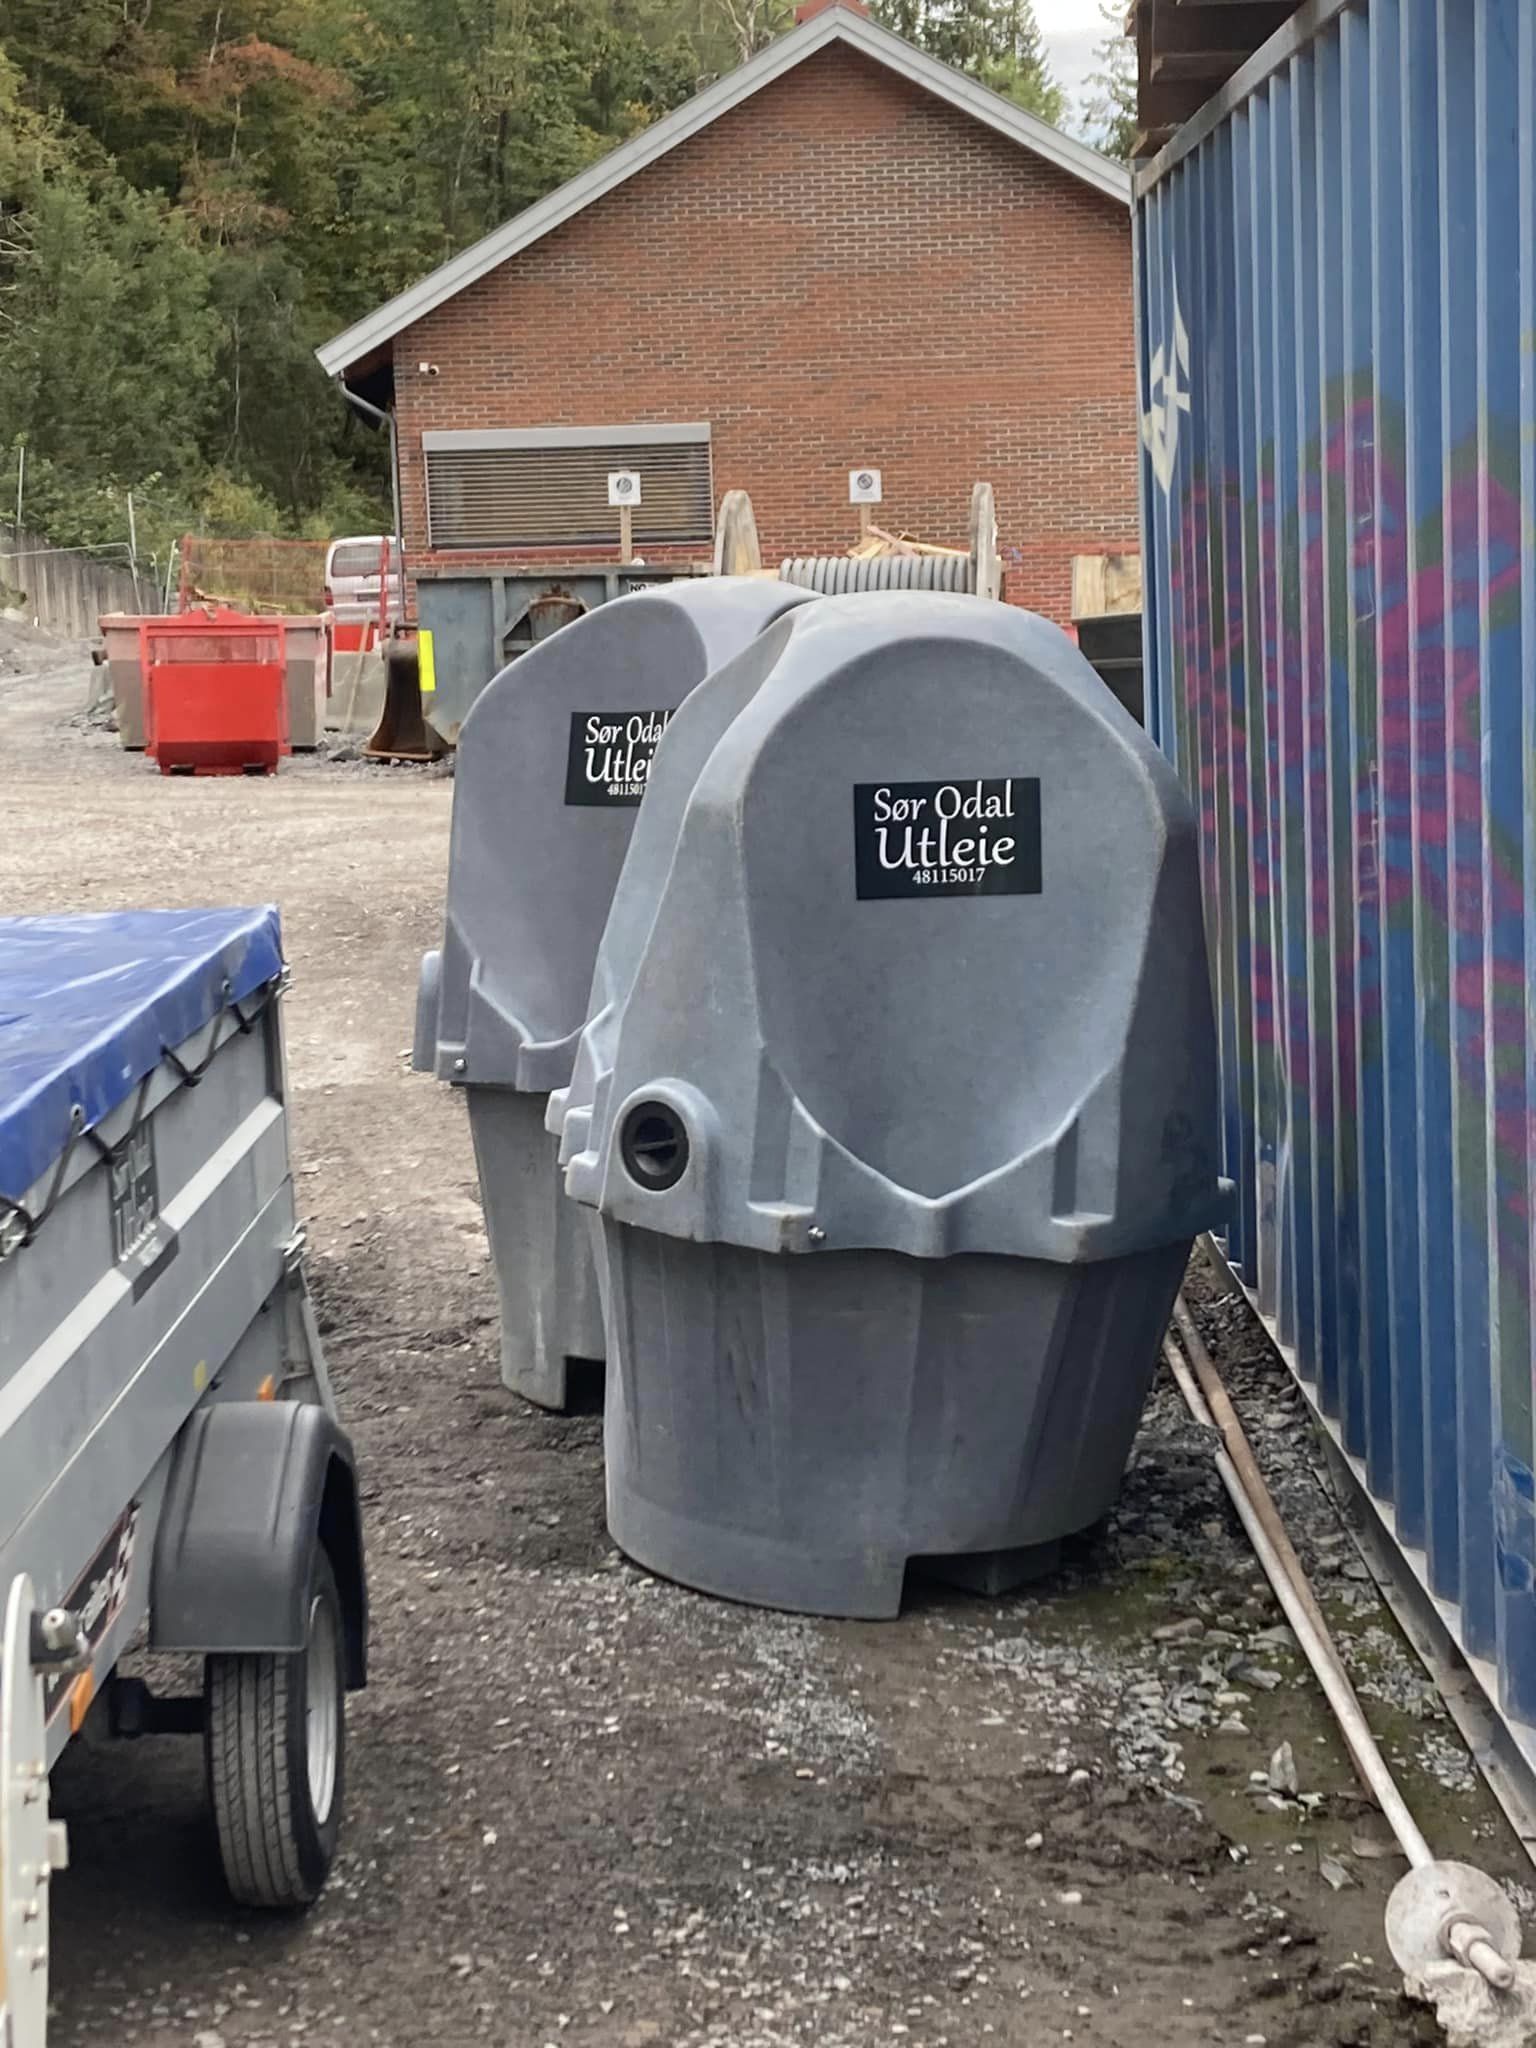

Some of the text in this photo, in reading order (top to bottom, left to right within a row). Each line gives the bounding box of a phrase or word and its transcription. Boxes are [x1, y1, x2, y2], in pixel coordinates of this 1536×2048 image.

[585, 716, 623, 744] Sør
[584, 741, 654, 783] Utlei
[874, 779, 1016, 821] Sør Odal
[874, 818, 1016, 869] Utleie
[912, 868, 986, 884] 48115017
